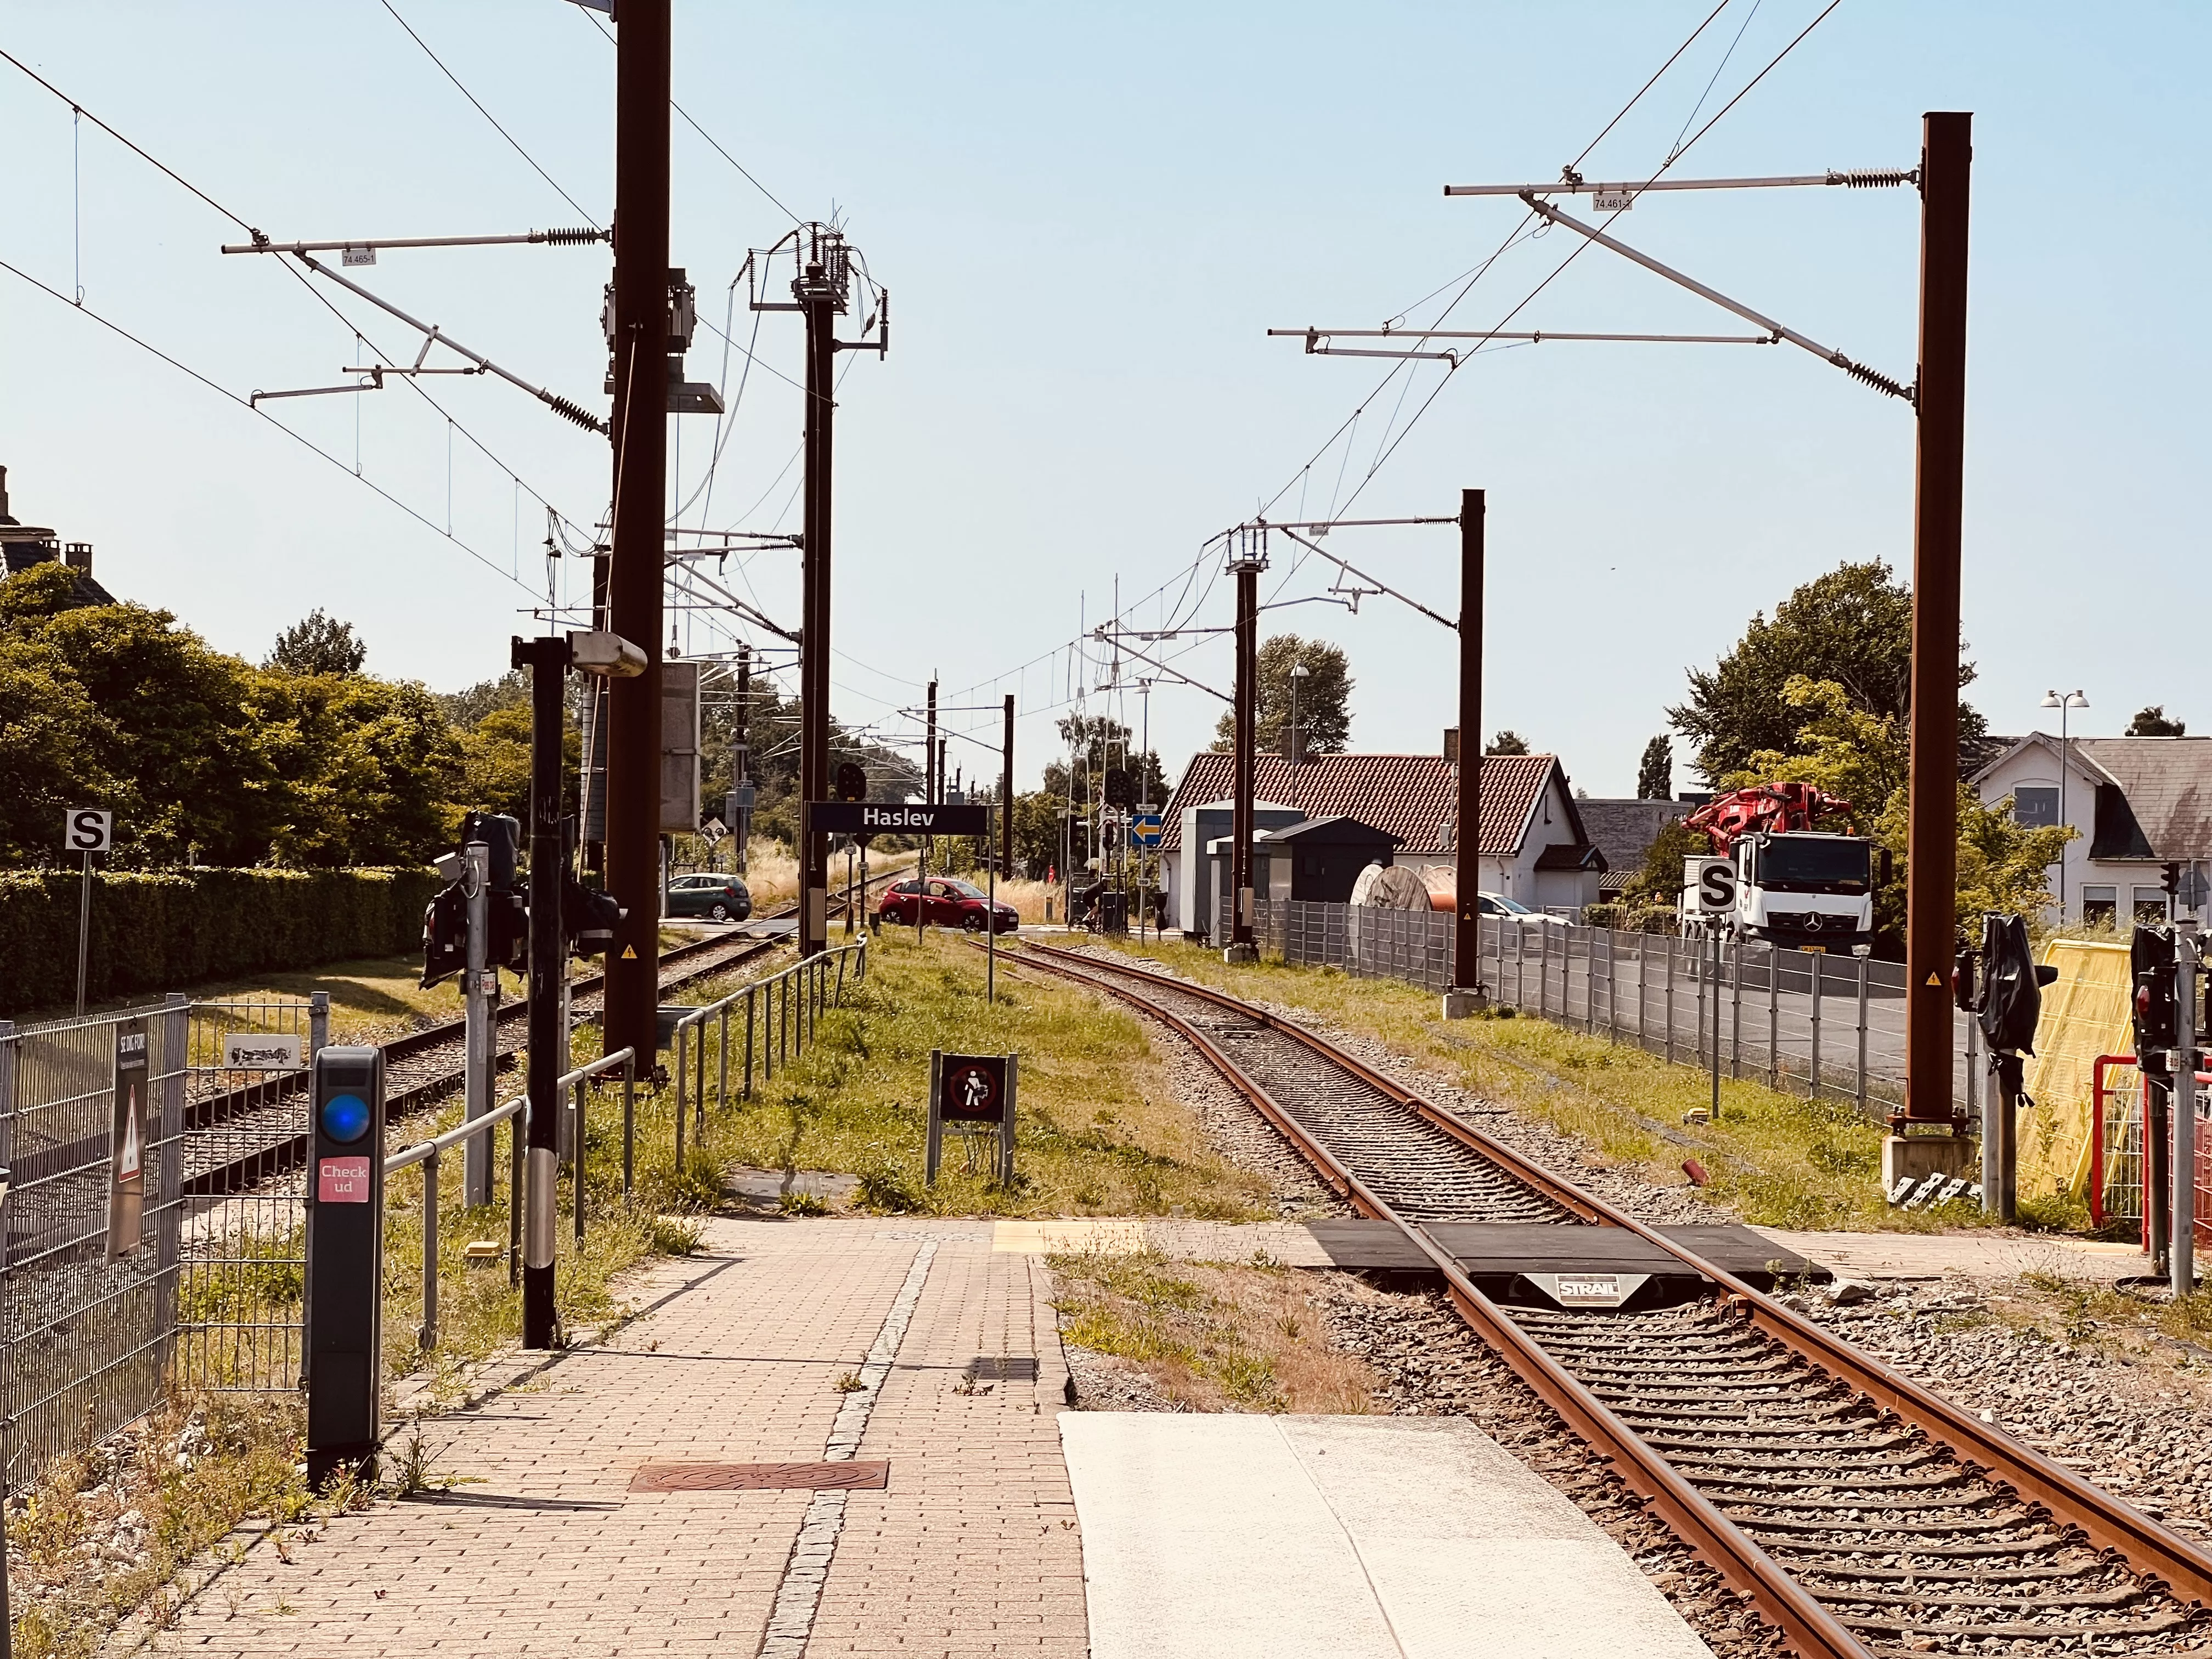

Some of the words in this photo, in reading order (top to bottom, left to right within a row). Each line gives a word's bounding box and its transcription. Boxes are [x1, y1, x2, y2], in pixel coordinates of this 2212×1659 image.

[343, 255, 374, 263] 74.465-1
[864, 808, 934, 826] Haslev
[72, 811, 104, 849] S
[1701, 865, 1735, 907] S
[321, 1165, 367, 1177] Check
[334, 1181, 353, 1192] ud
[1559, 1283, 1618, 1295] STRAIL
